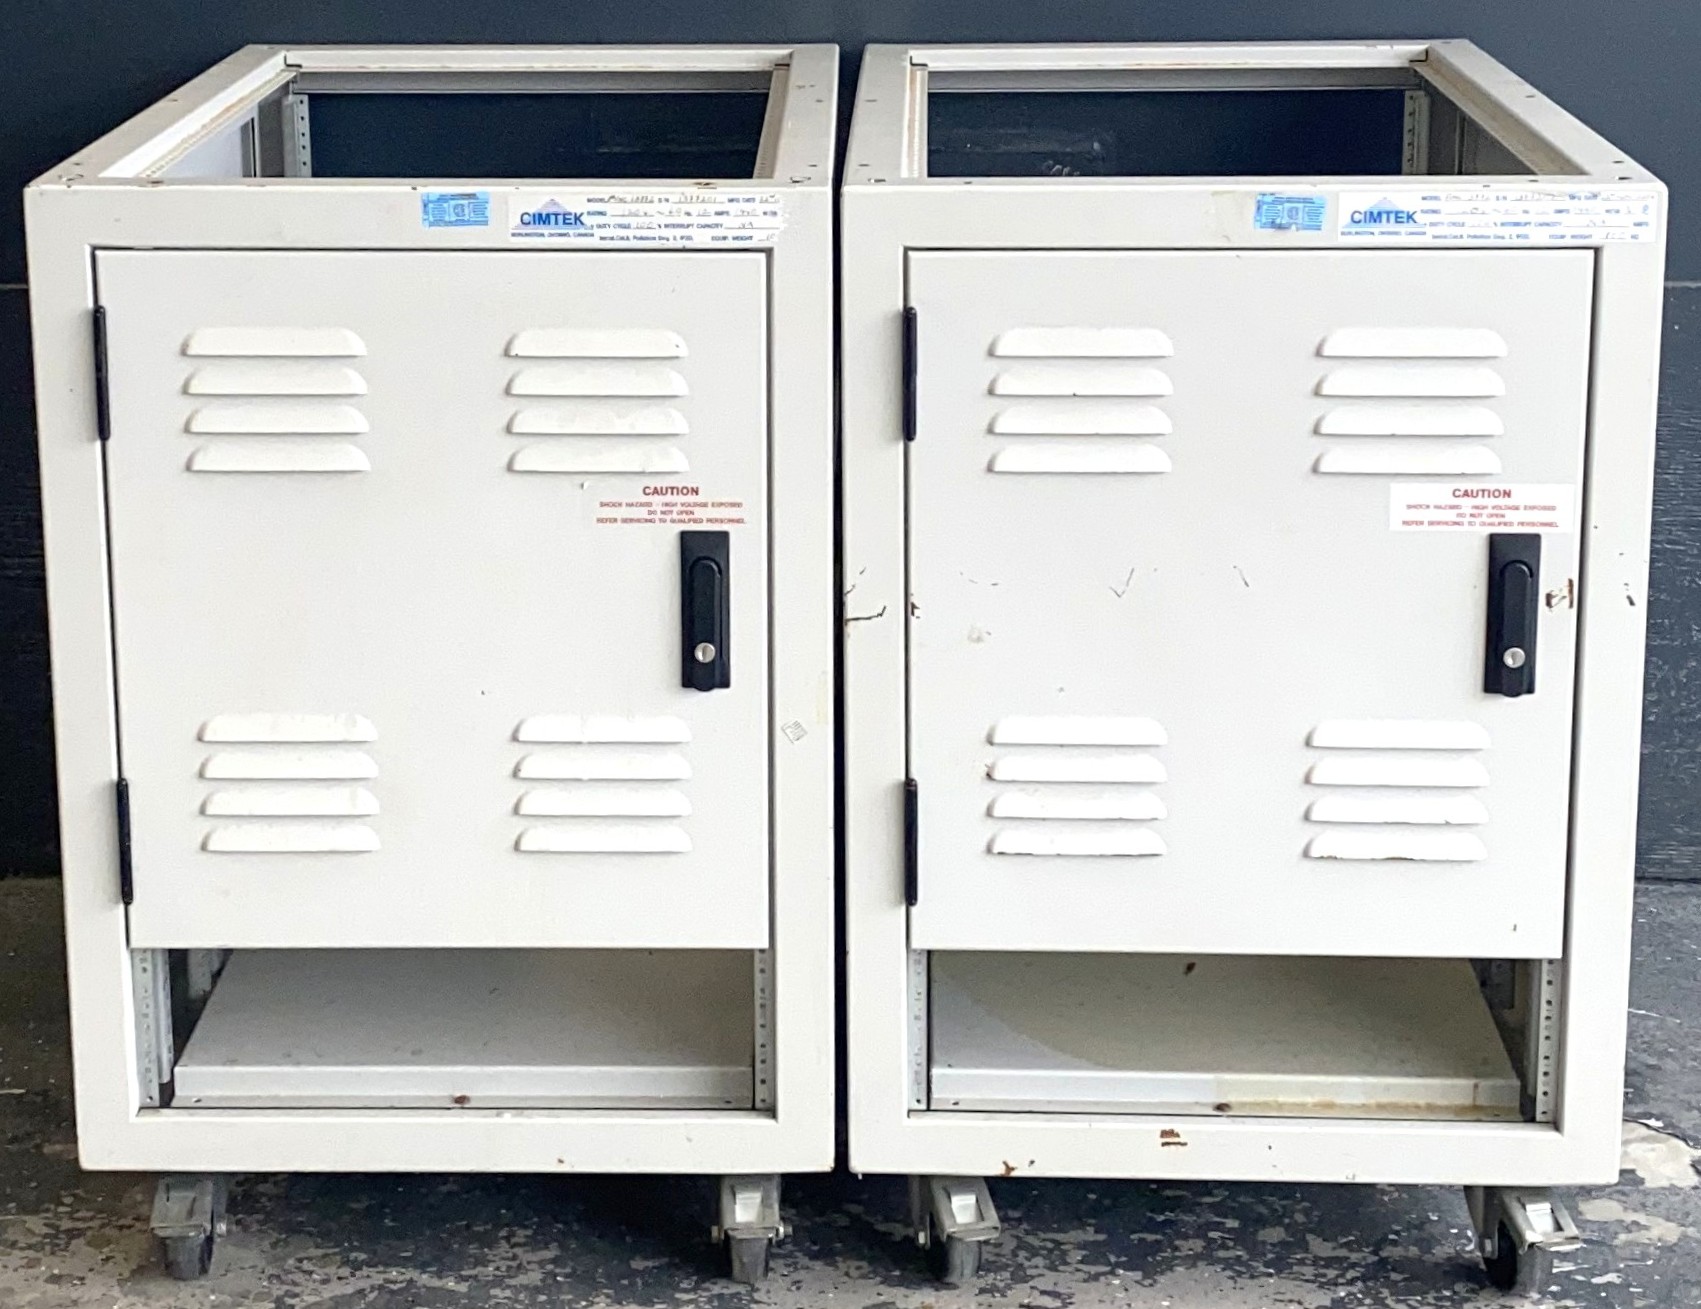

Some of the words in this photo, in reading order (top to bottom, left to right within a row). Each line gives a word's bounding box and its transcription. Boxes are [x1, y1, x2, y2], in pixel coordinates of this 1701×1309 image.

[520, 211, 585, 226] CIMTEK
[1350, 210, 1418, 224] CIMTEK
[642, 486, 700, 496] CAUTION
[1452, 488, 1511, 499] CAUTION
